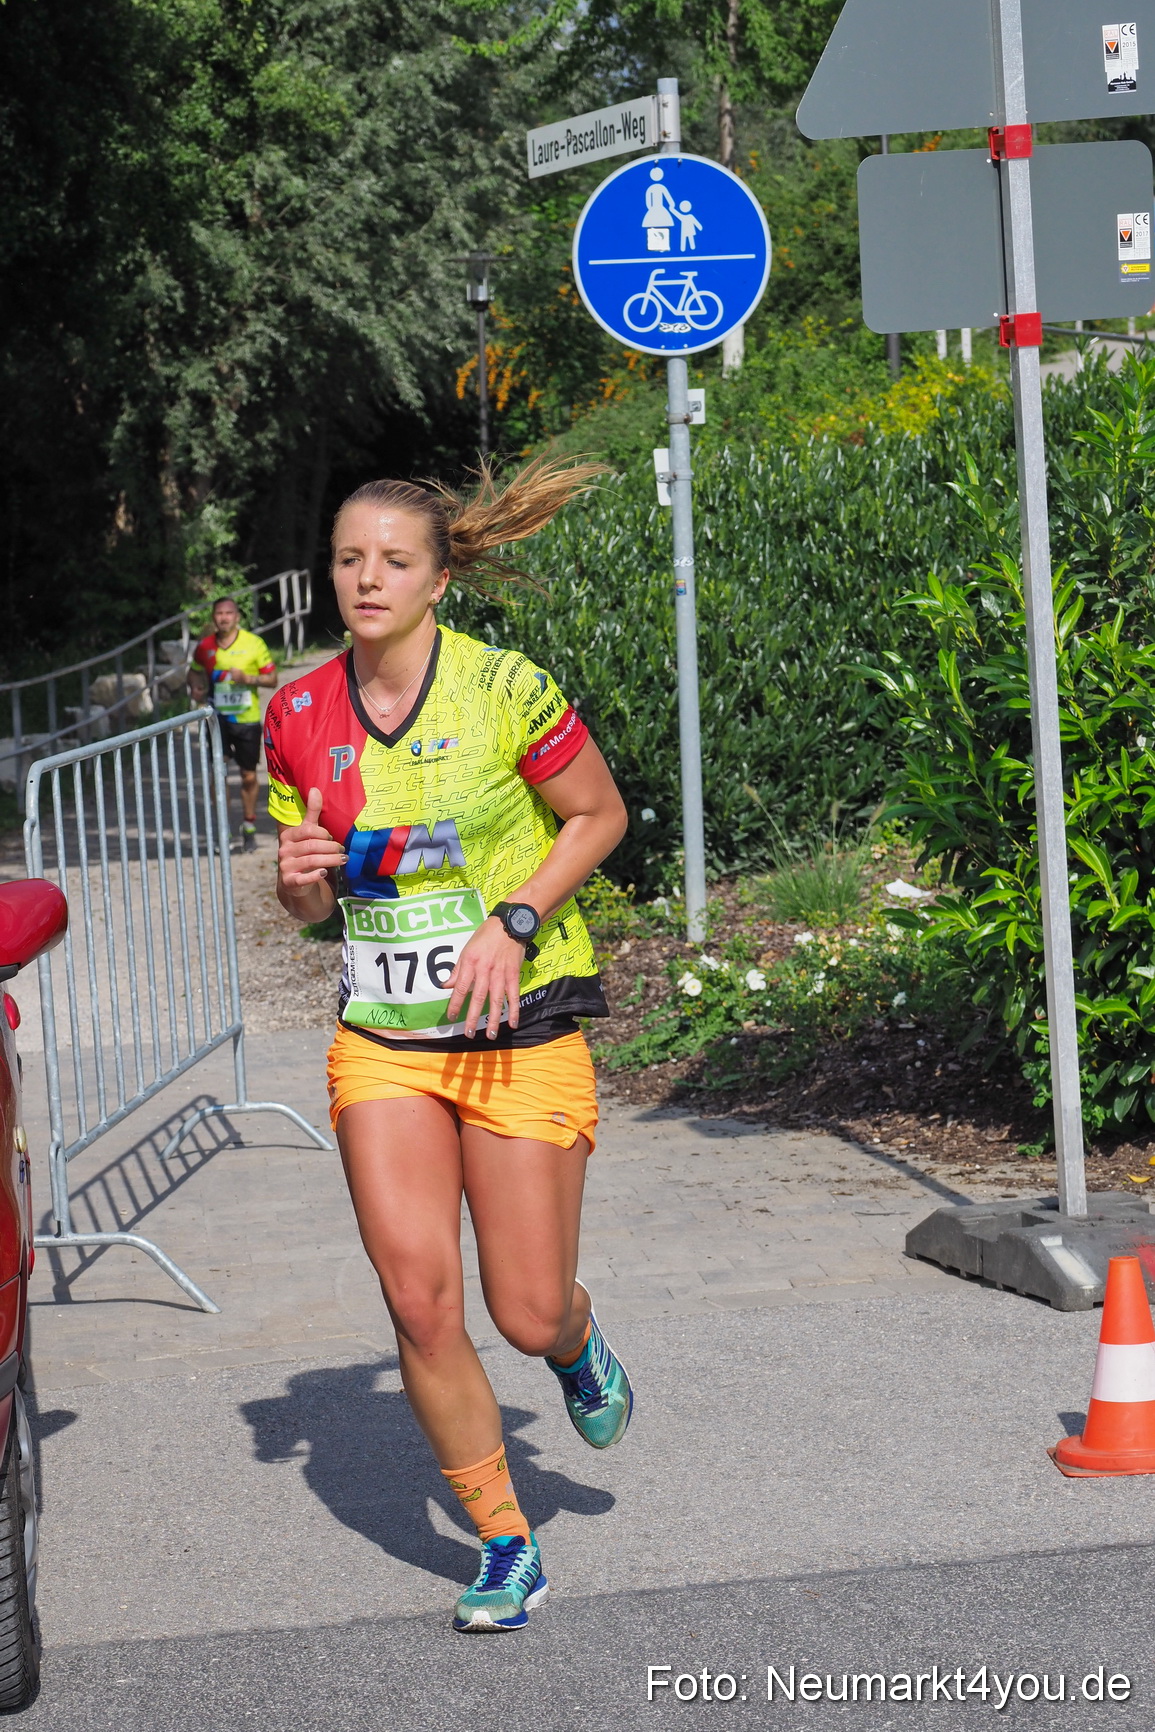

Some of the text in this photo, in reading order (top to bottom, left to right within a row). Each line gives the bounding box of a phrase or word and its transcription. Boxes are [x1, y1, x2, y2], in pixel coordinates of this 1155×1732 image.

[532, 111, 646, 166] Laure-Pascallon-Weg
[353, 899, 468, 935] BOCK
[375, 945, 456, 995] 176
[365, 1008, 407, 1027] NORA
